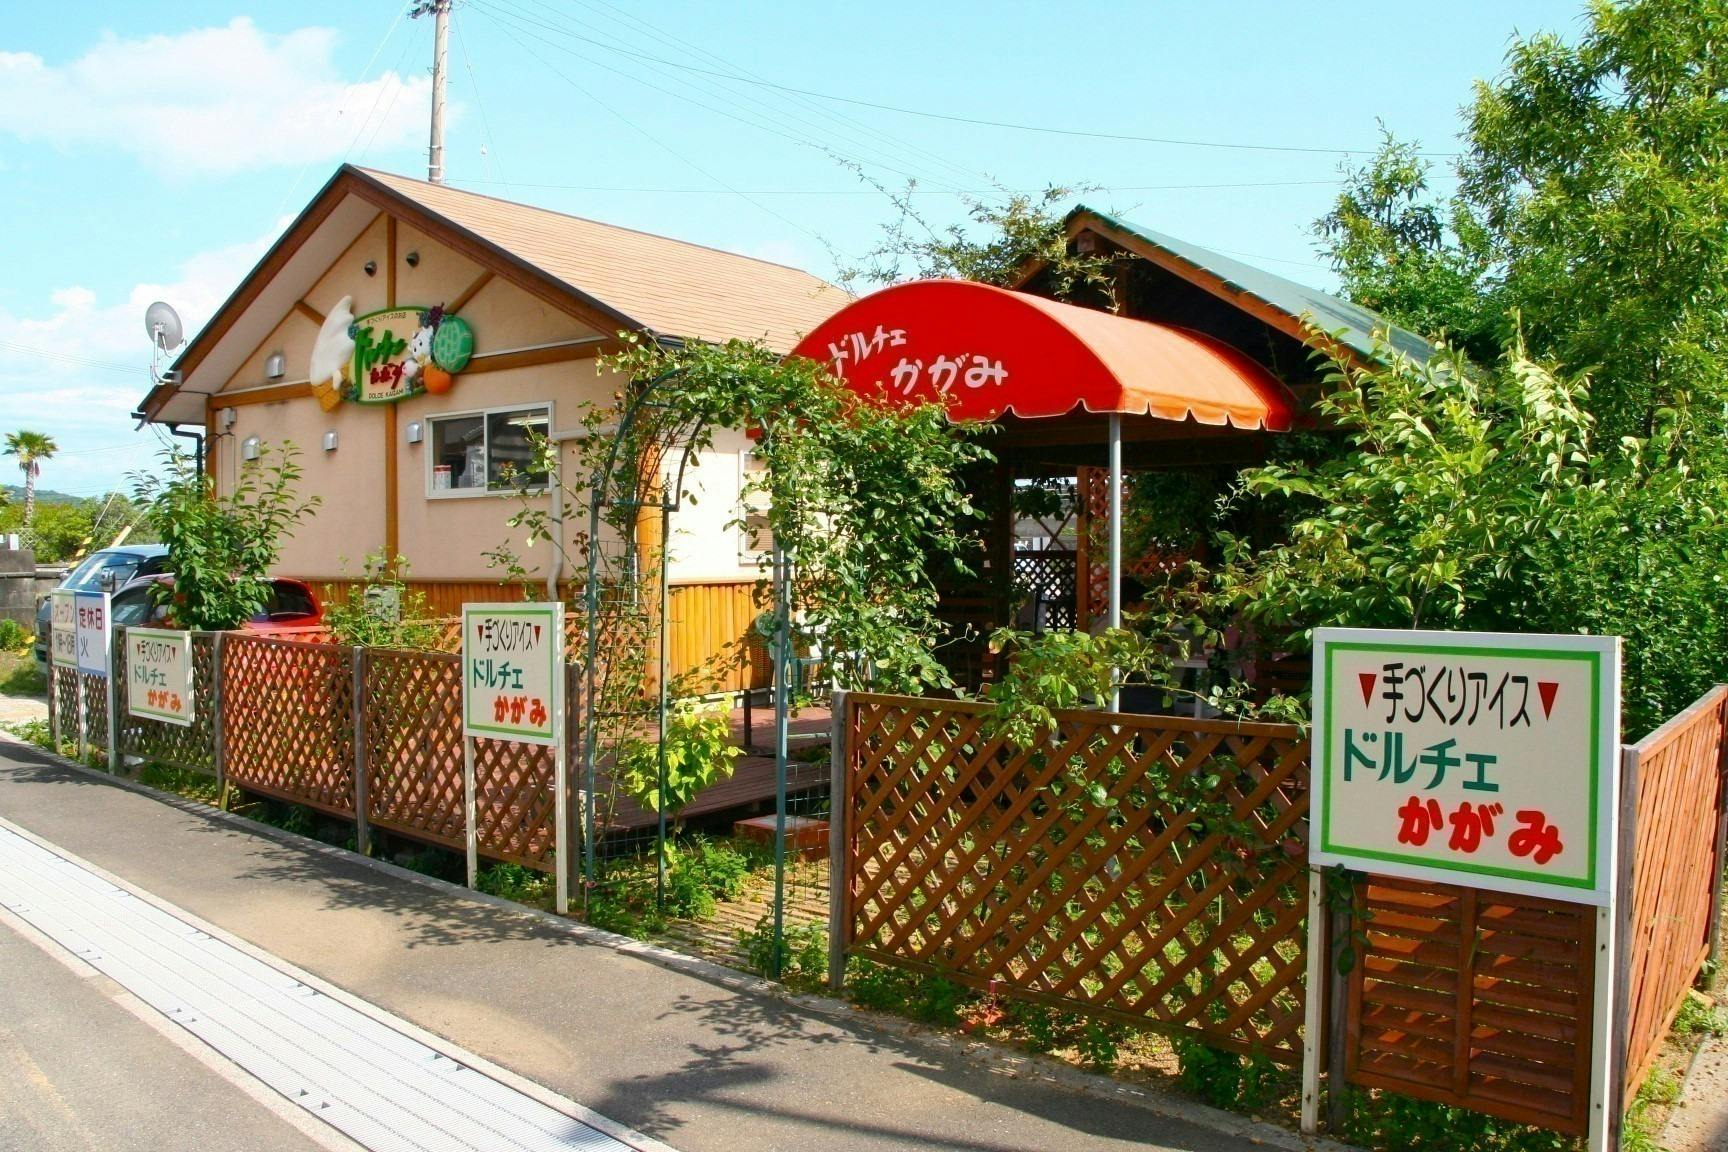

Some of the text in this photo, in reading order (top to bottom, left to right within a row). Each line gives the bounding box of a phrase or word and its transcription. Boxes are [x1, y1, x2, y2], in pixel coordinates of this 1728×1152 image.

[827, 324, 907, 379] ドルチェ
[890, 352, 1009, 396] かがみ
[368, 391, 384, 399] DOLCE
[78, 607, 103, 630] 定休日
[80, 637, 90, 658] 火
[141, 639, 173, 664] 手づくりアイス
[484, 618, 533, 653] 手づくりアイス
[134, 665, 167, 687] ドルチェ
[473, 658, 524, 690] ドルチェ
[147, 689, 182, 713] かがみ
[494, 695, 547, 727] かがみ
[1381, 662, 1532, 730] 手づくりアイス
[1343, 728, 1500, 792] ドルチェ
[1397, 795, 1564, 866] かがみ
